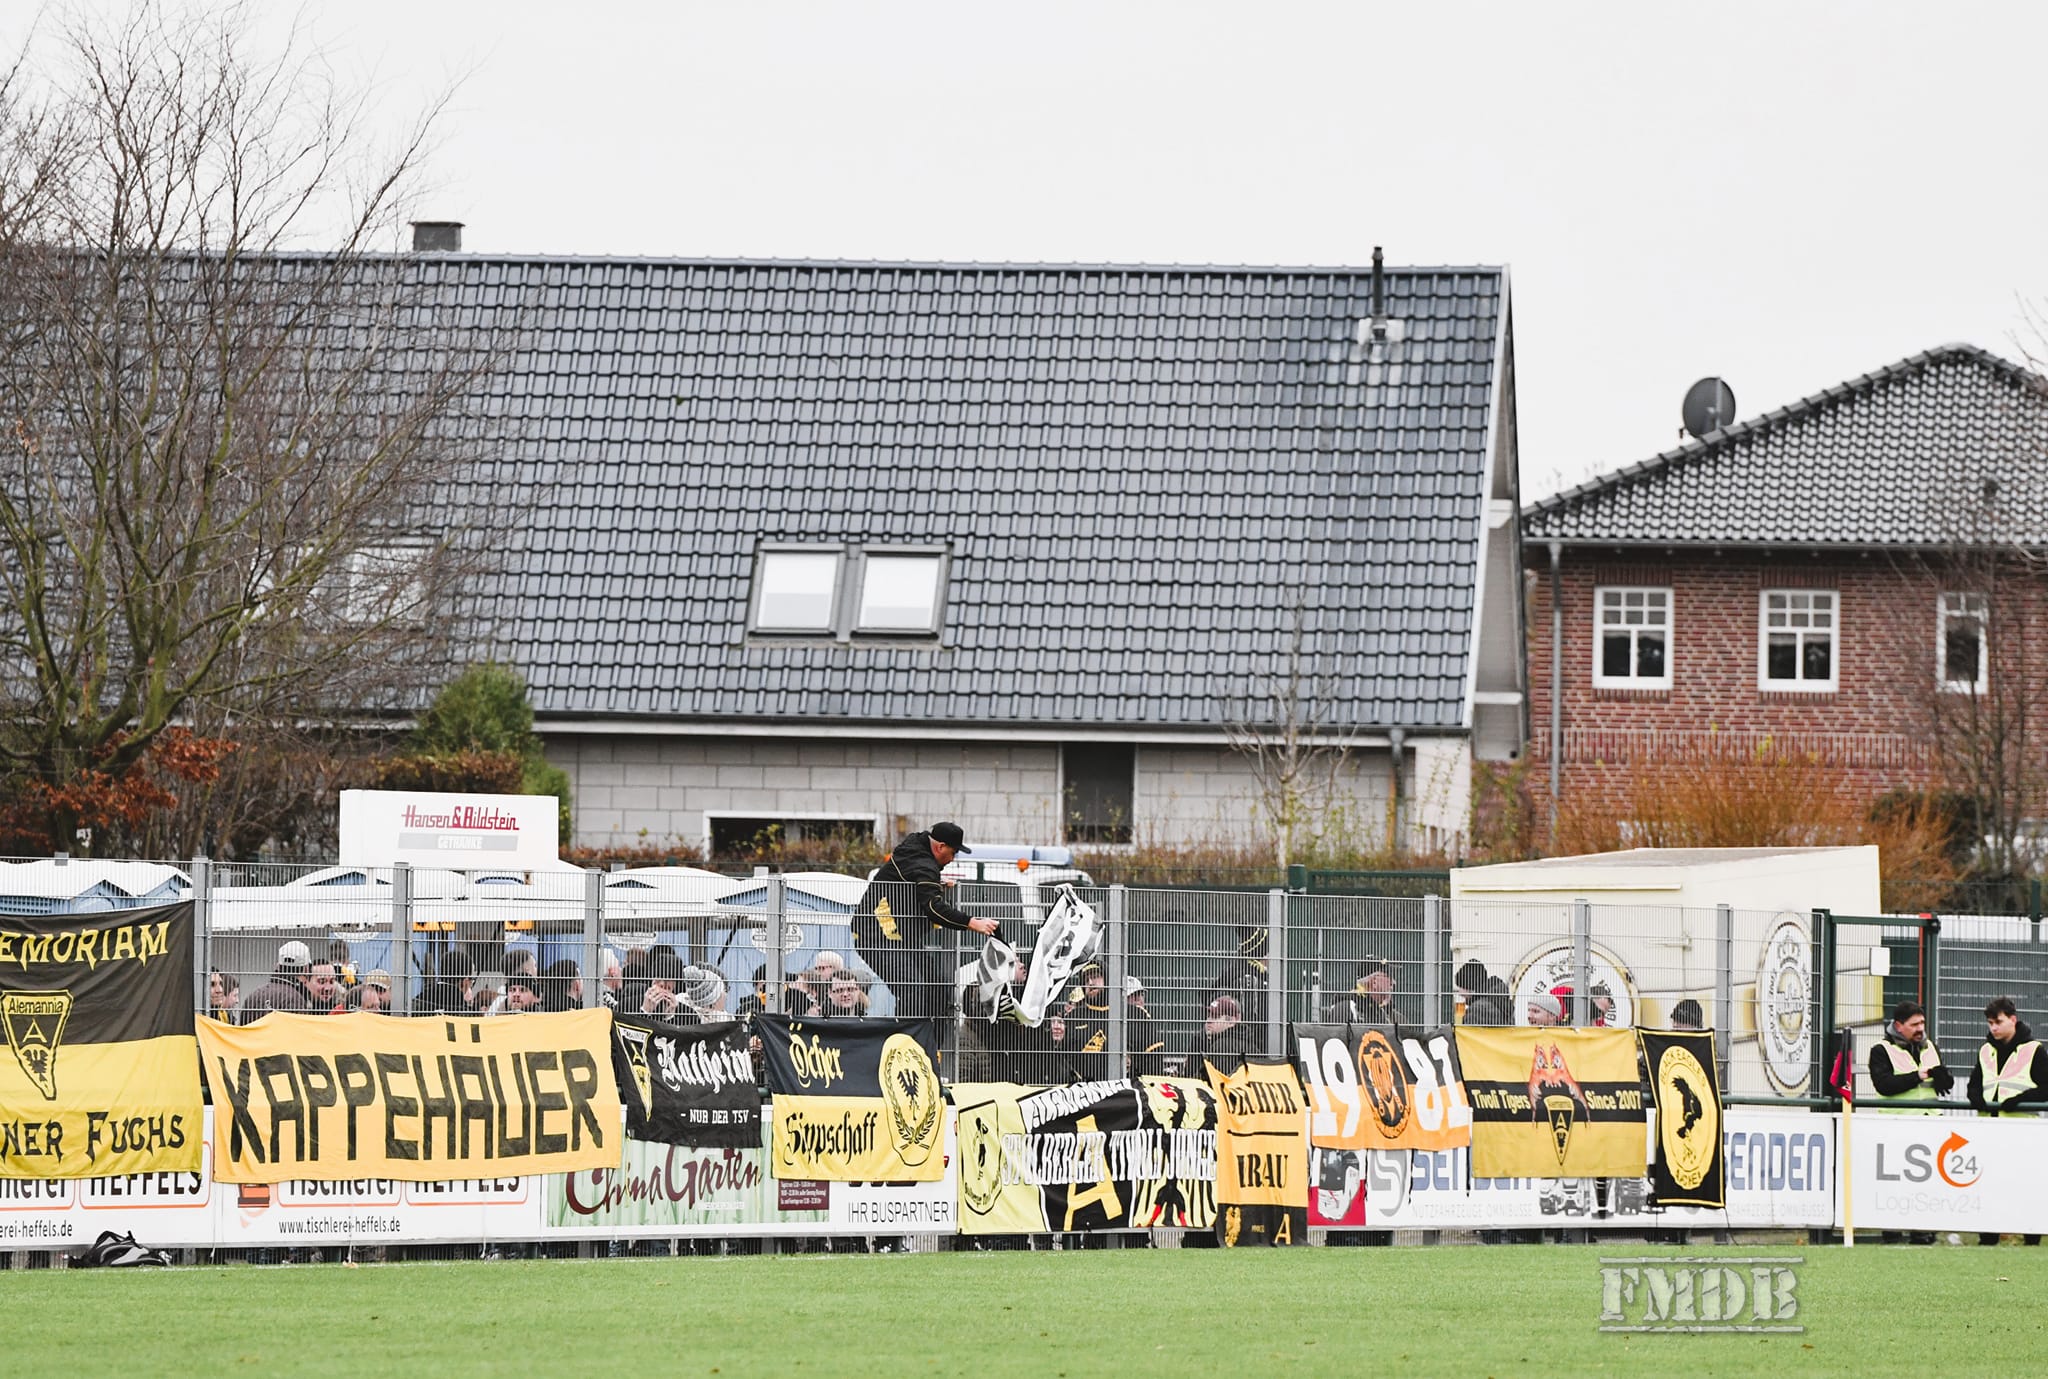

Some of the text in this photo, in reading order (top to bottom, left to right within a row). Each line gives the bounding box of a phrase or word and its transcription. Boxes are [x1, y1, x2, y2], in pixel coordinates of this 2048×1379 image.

[8, 997, 64, 1015] Alemannia
[789, 1022, 844, 1088] Öcher
[219, 1022, 603, 1163] KAPPEHÄUER
[1472, 1090, 1500, 1109] Tivoli
[1499, 1091, 1531, 1114] Tigers
[1585, 1090, 1615, 1109] Since
[1616, 1090, 1642, 1110] 2007
[690, 1109, 749, 1124] NUR DER TSV
[0, 1112, 185, 1167] NER FUCHS
[1723, 1132, 1825, 1191] ENDEN
[848, 1202, 868, 1222] IHR
[872, 1201, 949, 1222] BUSPARTNER
[1875, 1192, 1982, 1215] LogiServ24
[279, 1217, 401, 1234] www.tischlerei-heffels.de
